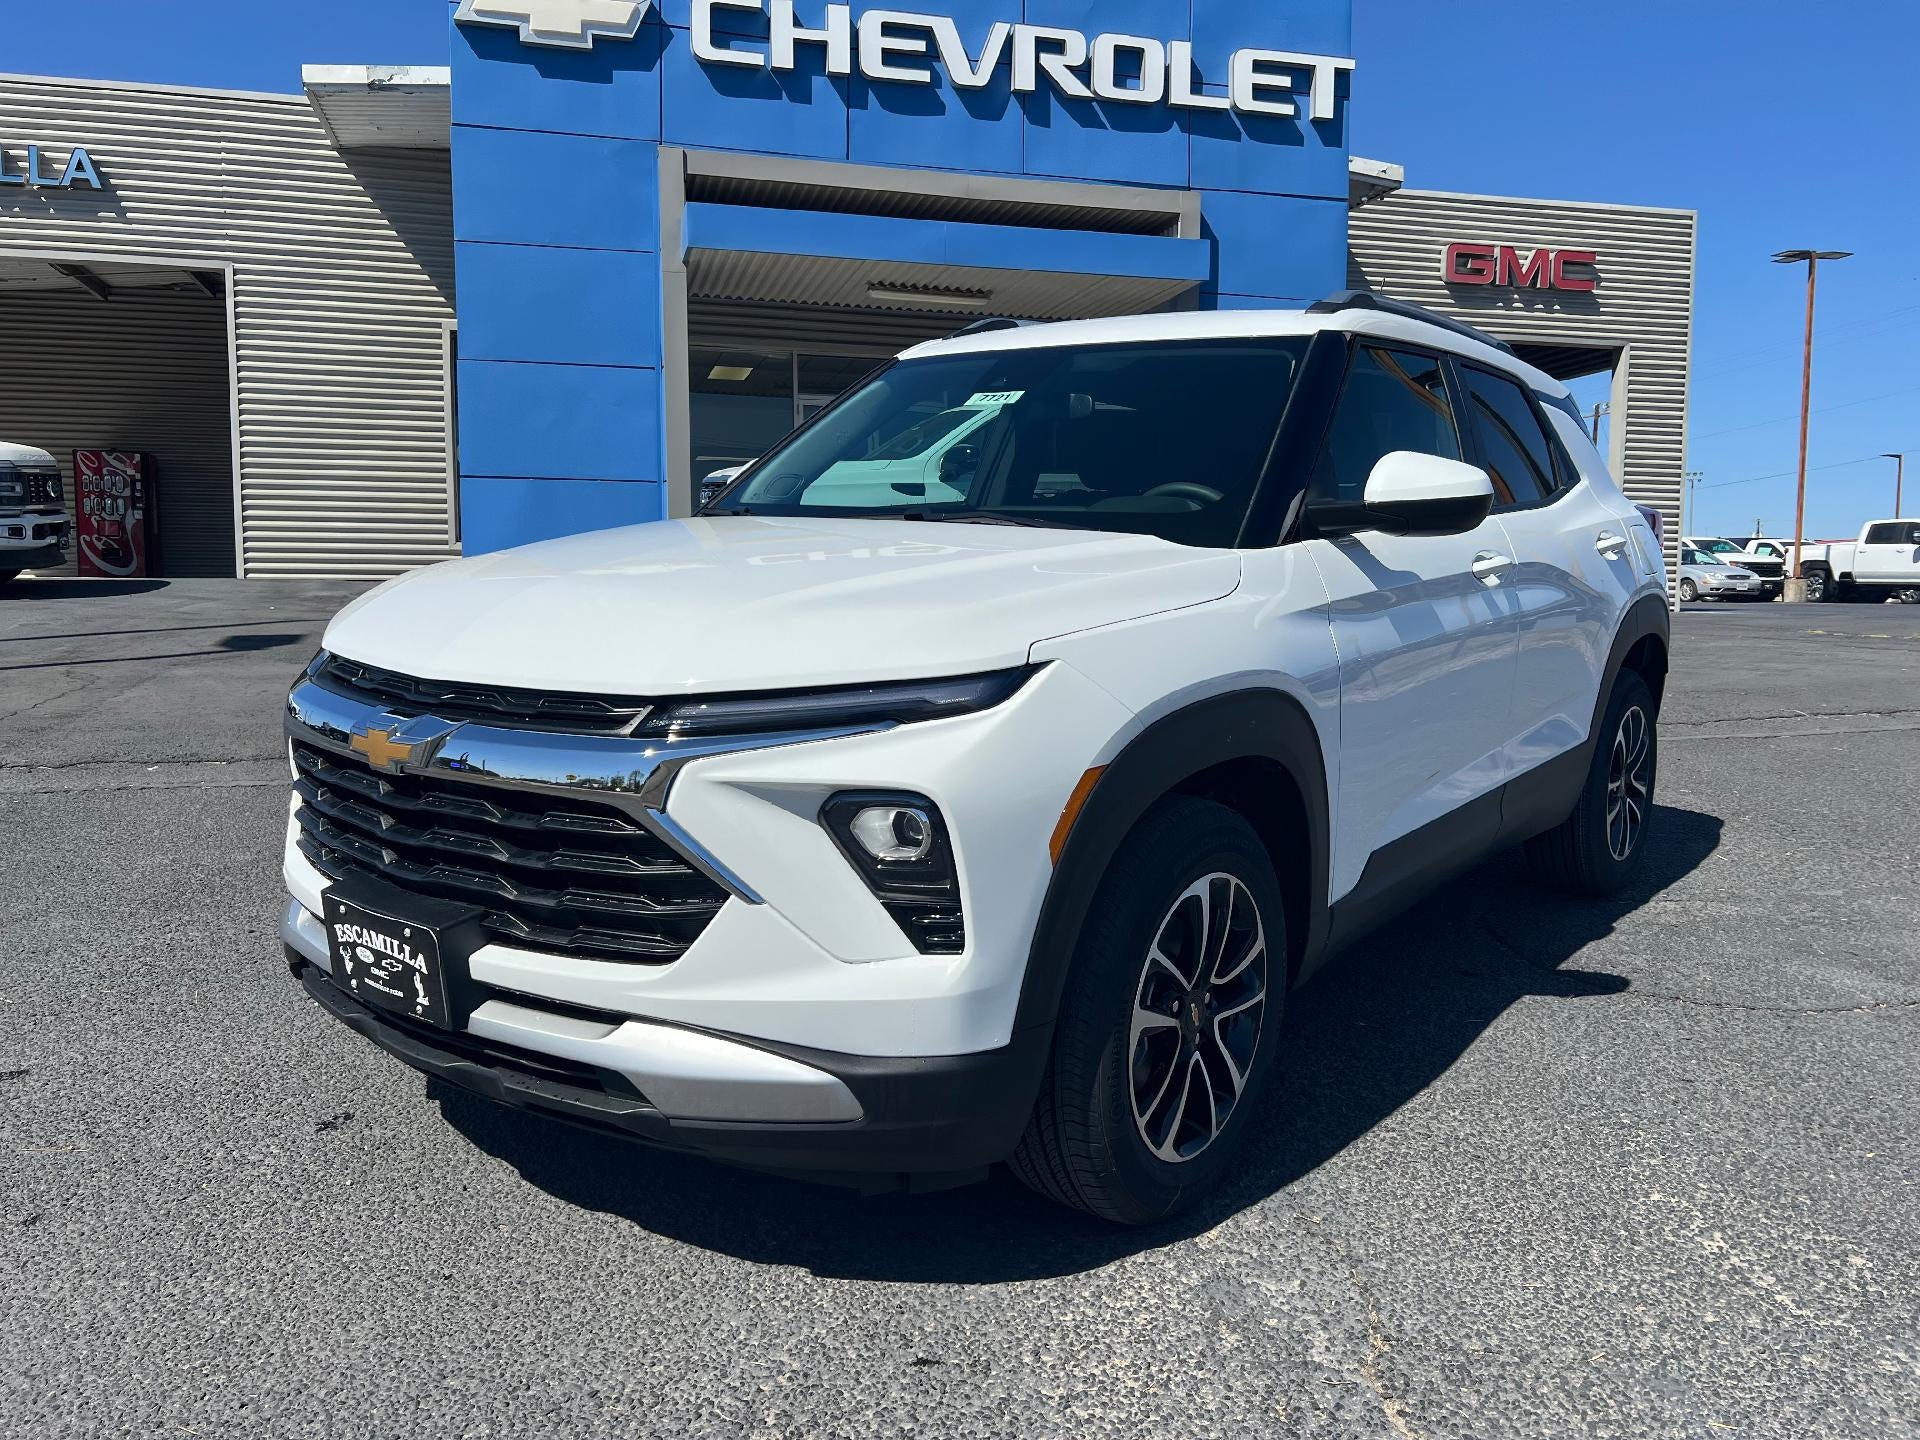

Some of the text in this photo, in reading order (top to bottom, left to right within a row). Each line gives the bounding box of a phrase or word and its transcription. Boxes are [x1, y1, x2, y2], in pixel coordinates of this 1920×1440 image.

[690, 0, 1356, 119] CHEVROLET
[0, 145, 102, 189] LLA
[1441, 243, 1596, 290] GMC
[980, 394, 1011, 402] 7721
[333, 923, 428, 975] ESCAMILLA
